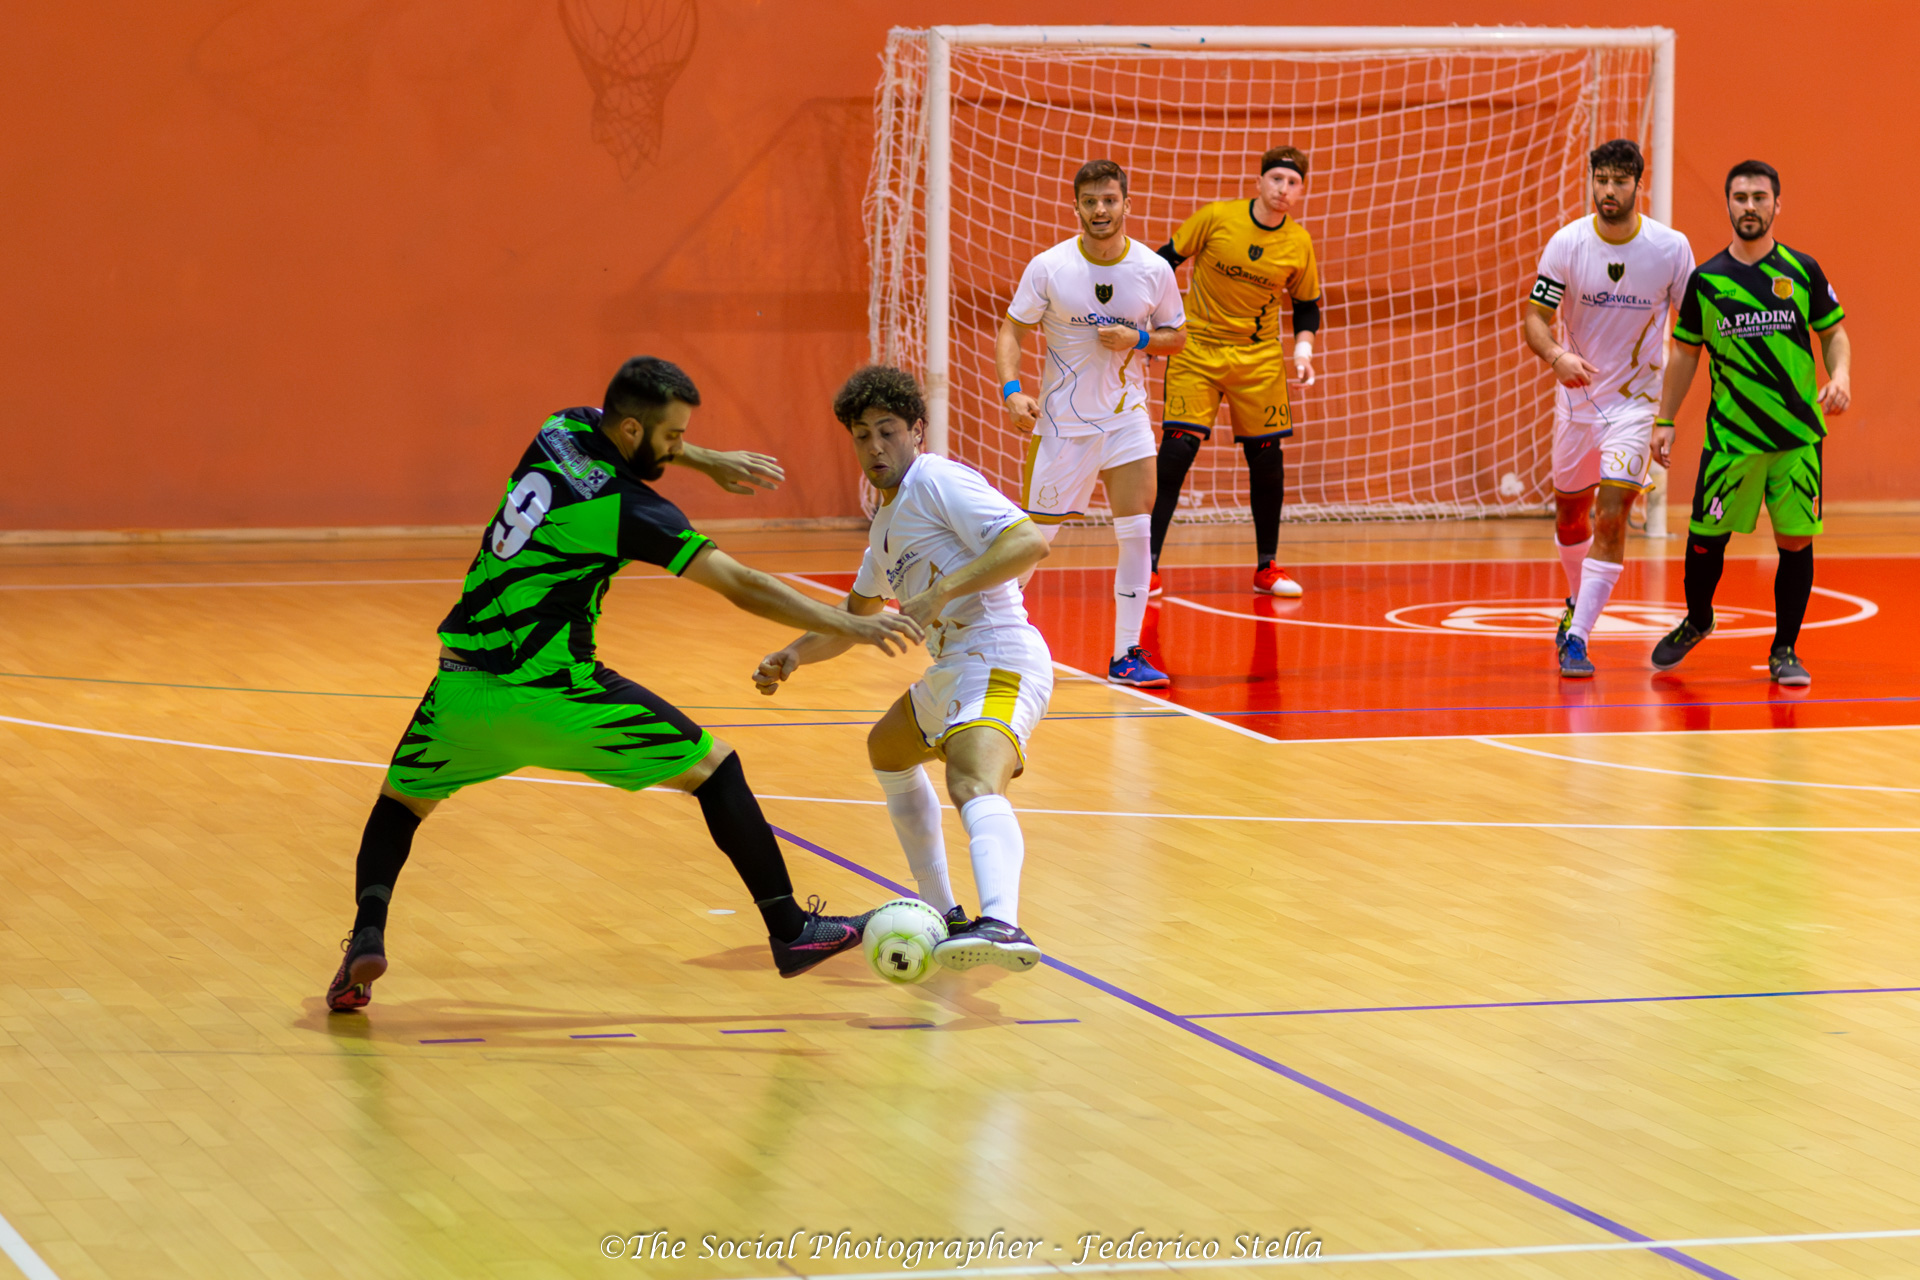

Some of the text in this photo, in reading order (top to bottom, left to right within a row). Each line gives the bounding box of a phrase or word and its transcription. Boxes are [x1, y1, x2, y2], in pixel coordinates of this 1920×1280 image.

[1716, 309, 1797, 331] LA PIADINA
[1264, 403, 1289, 427] 29
[1609, 450, 1644, 477] 80
[491, 471, 553, 560] 9
[1709, 496, 1724, 520] 4
